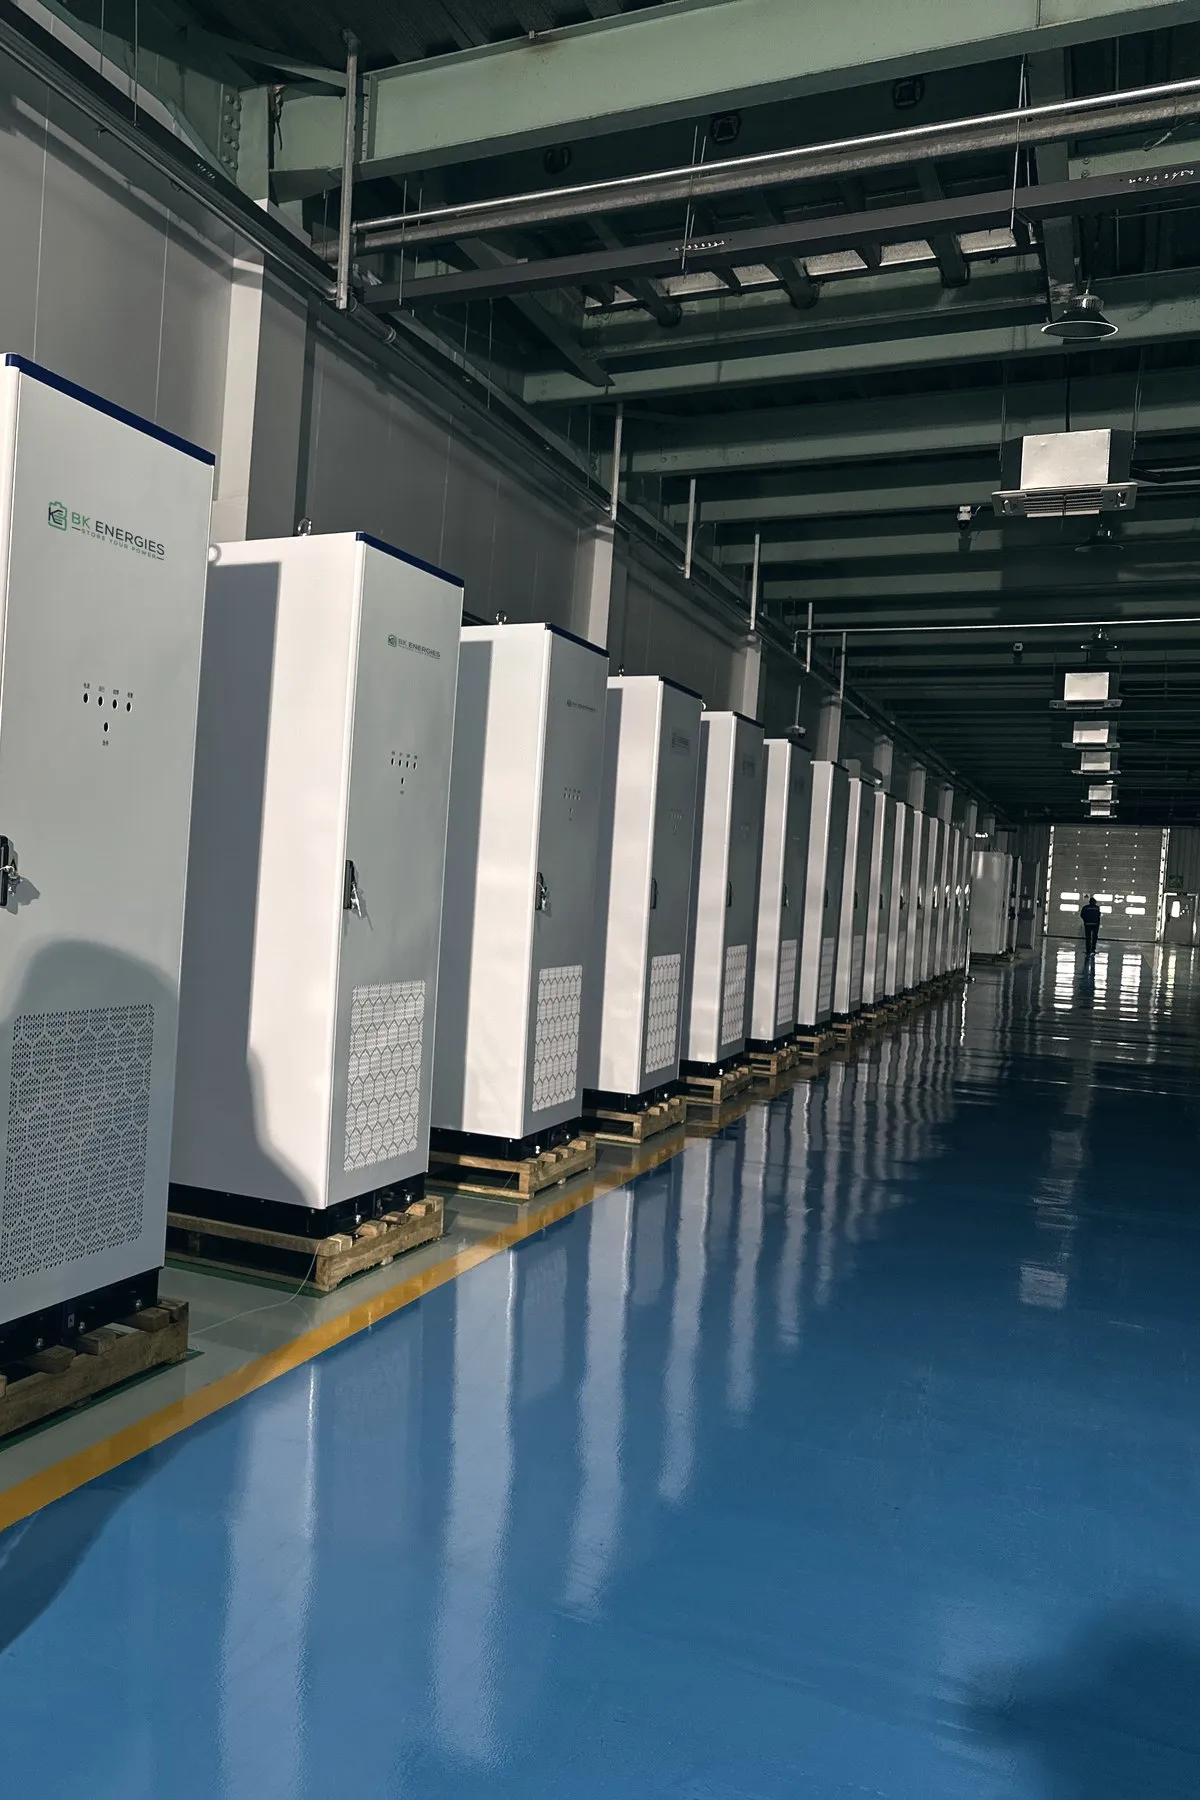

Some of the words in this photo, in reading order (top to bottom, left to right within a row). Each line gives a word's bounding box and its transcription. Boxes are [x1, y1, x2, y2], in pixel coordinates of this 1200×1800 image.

[71, 511, 91, 530] BK
[95, 520, 165, 556] ENERGIES
[408, 641, 441, 658] ENERGIES
